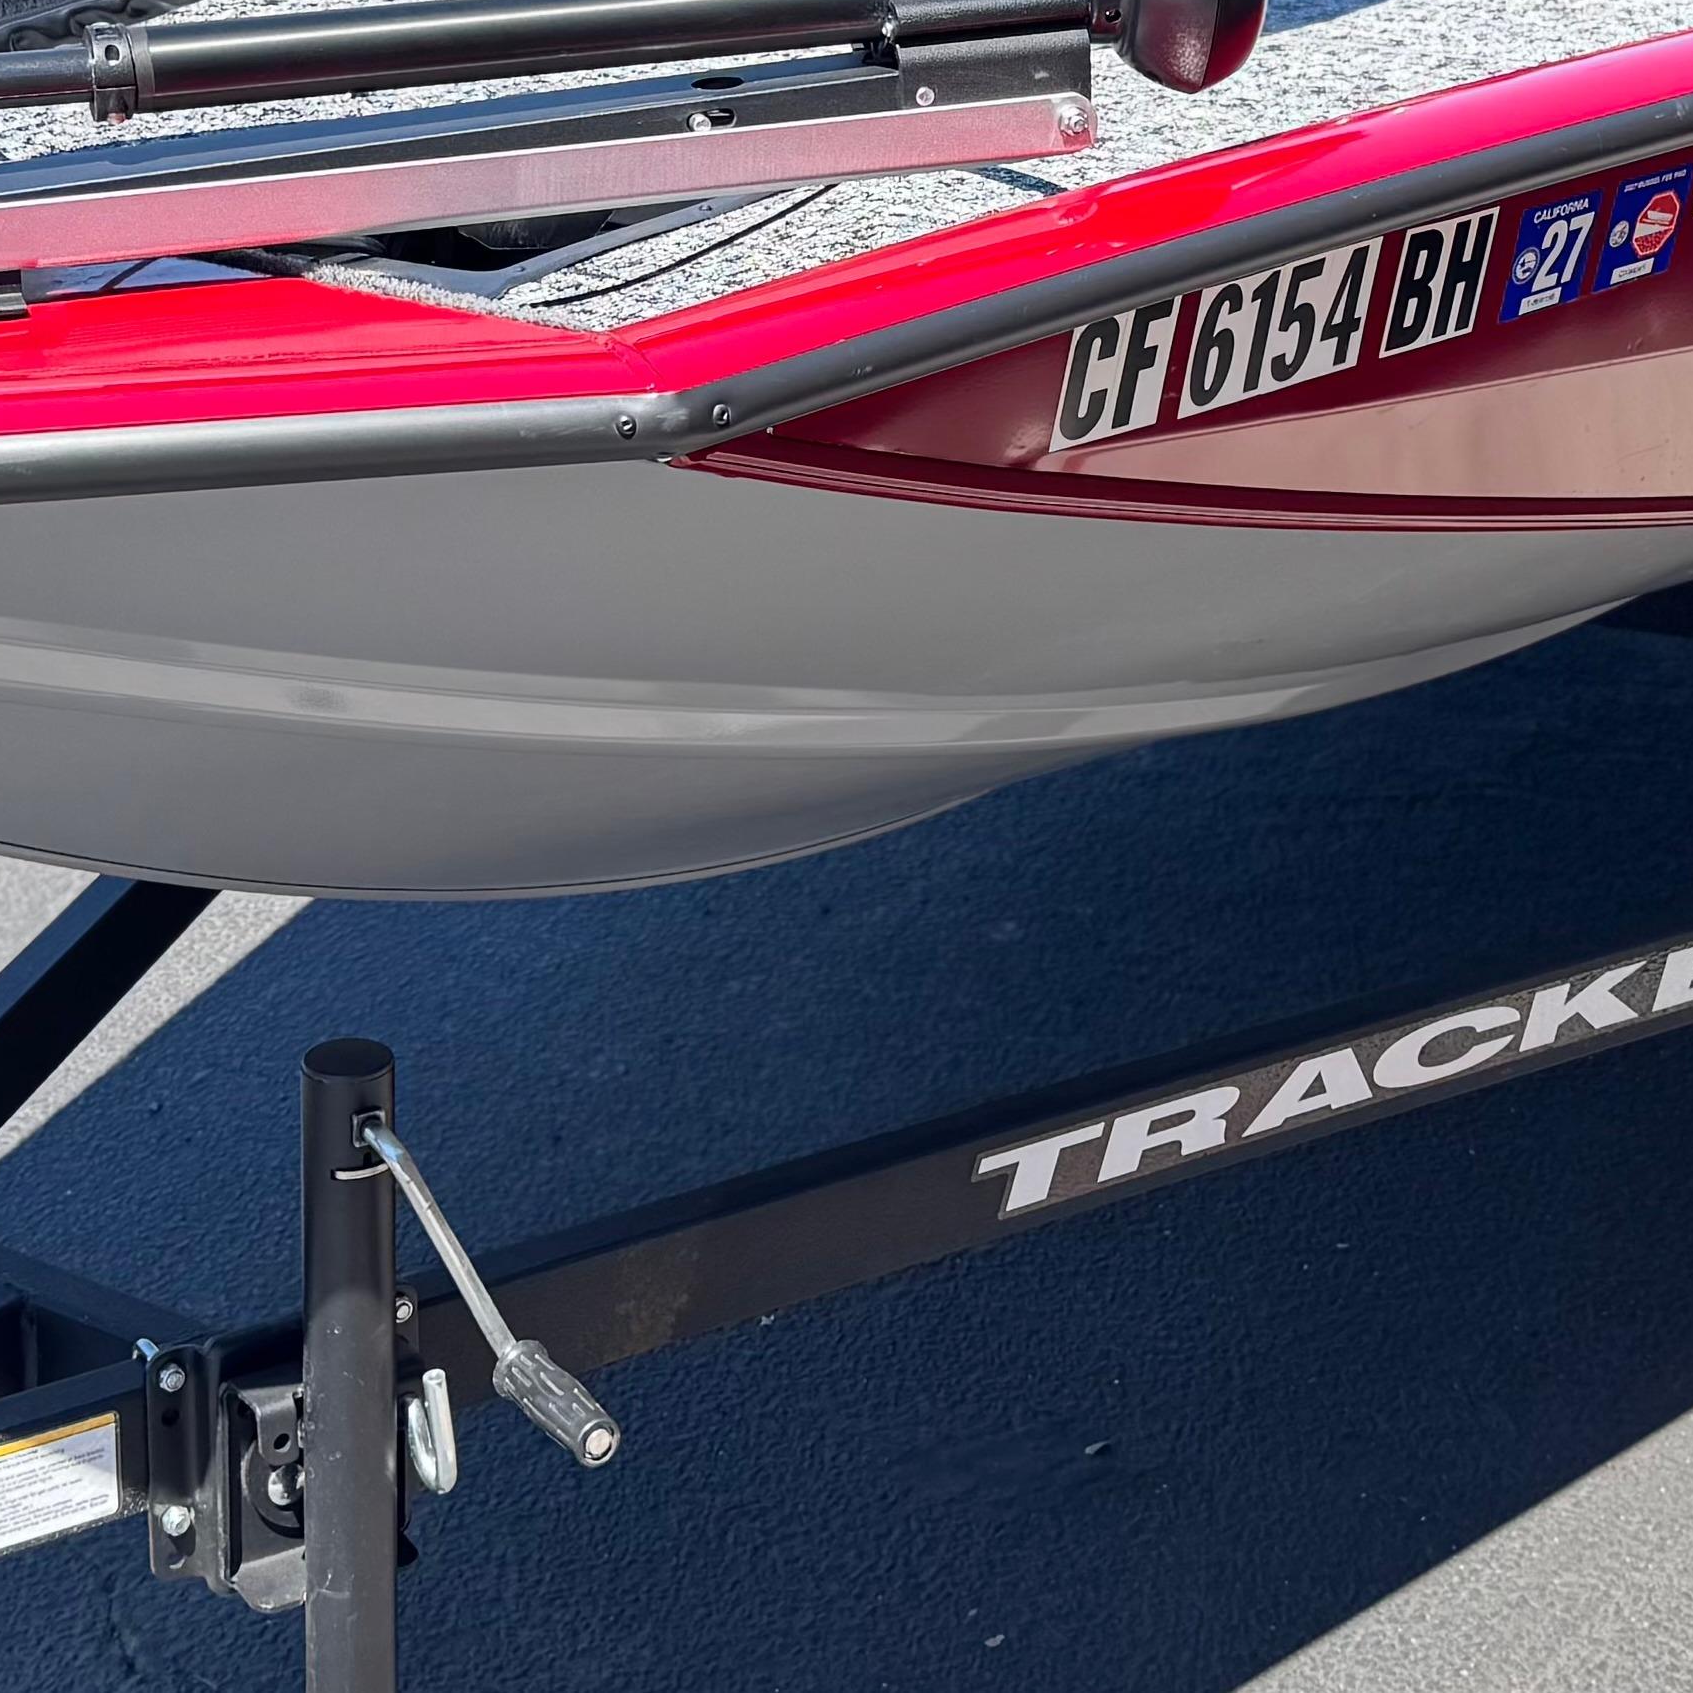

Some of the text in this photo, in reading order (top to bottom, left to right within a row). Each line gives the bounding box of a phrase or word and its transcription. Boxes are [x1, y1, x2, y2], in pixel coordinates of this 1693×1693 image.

[1531, 211, 1595, 292] 27
[1533, 198, 1590, 224] CALIFORNIA
[1059, 209, 1497, 441] CF 6154 BH
